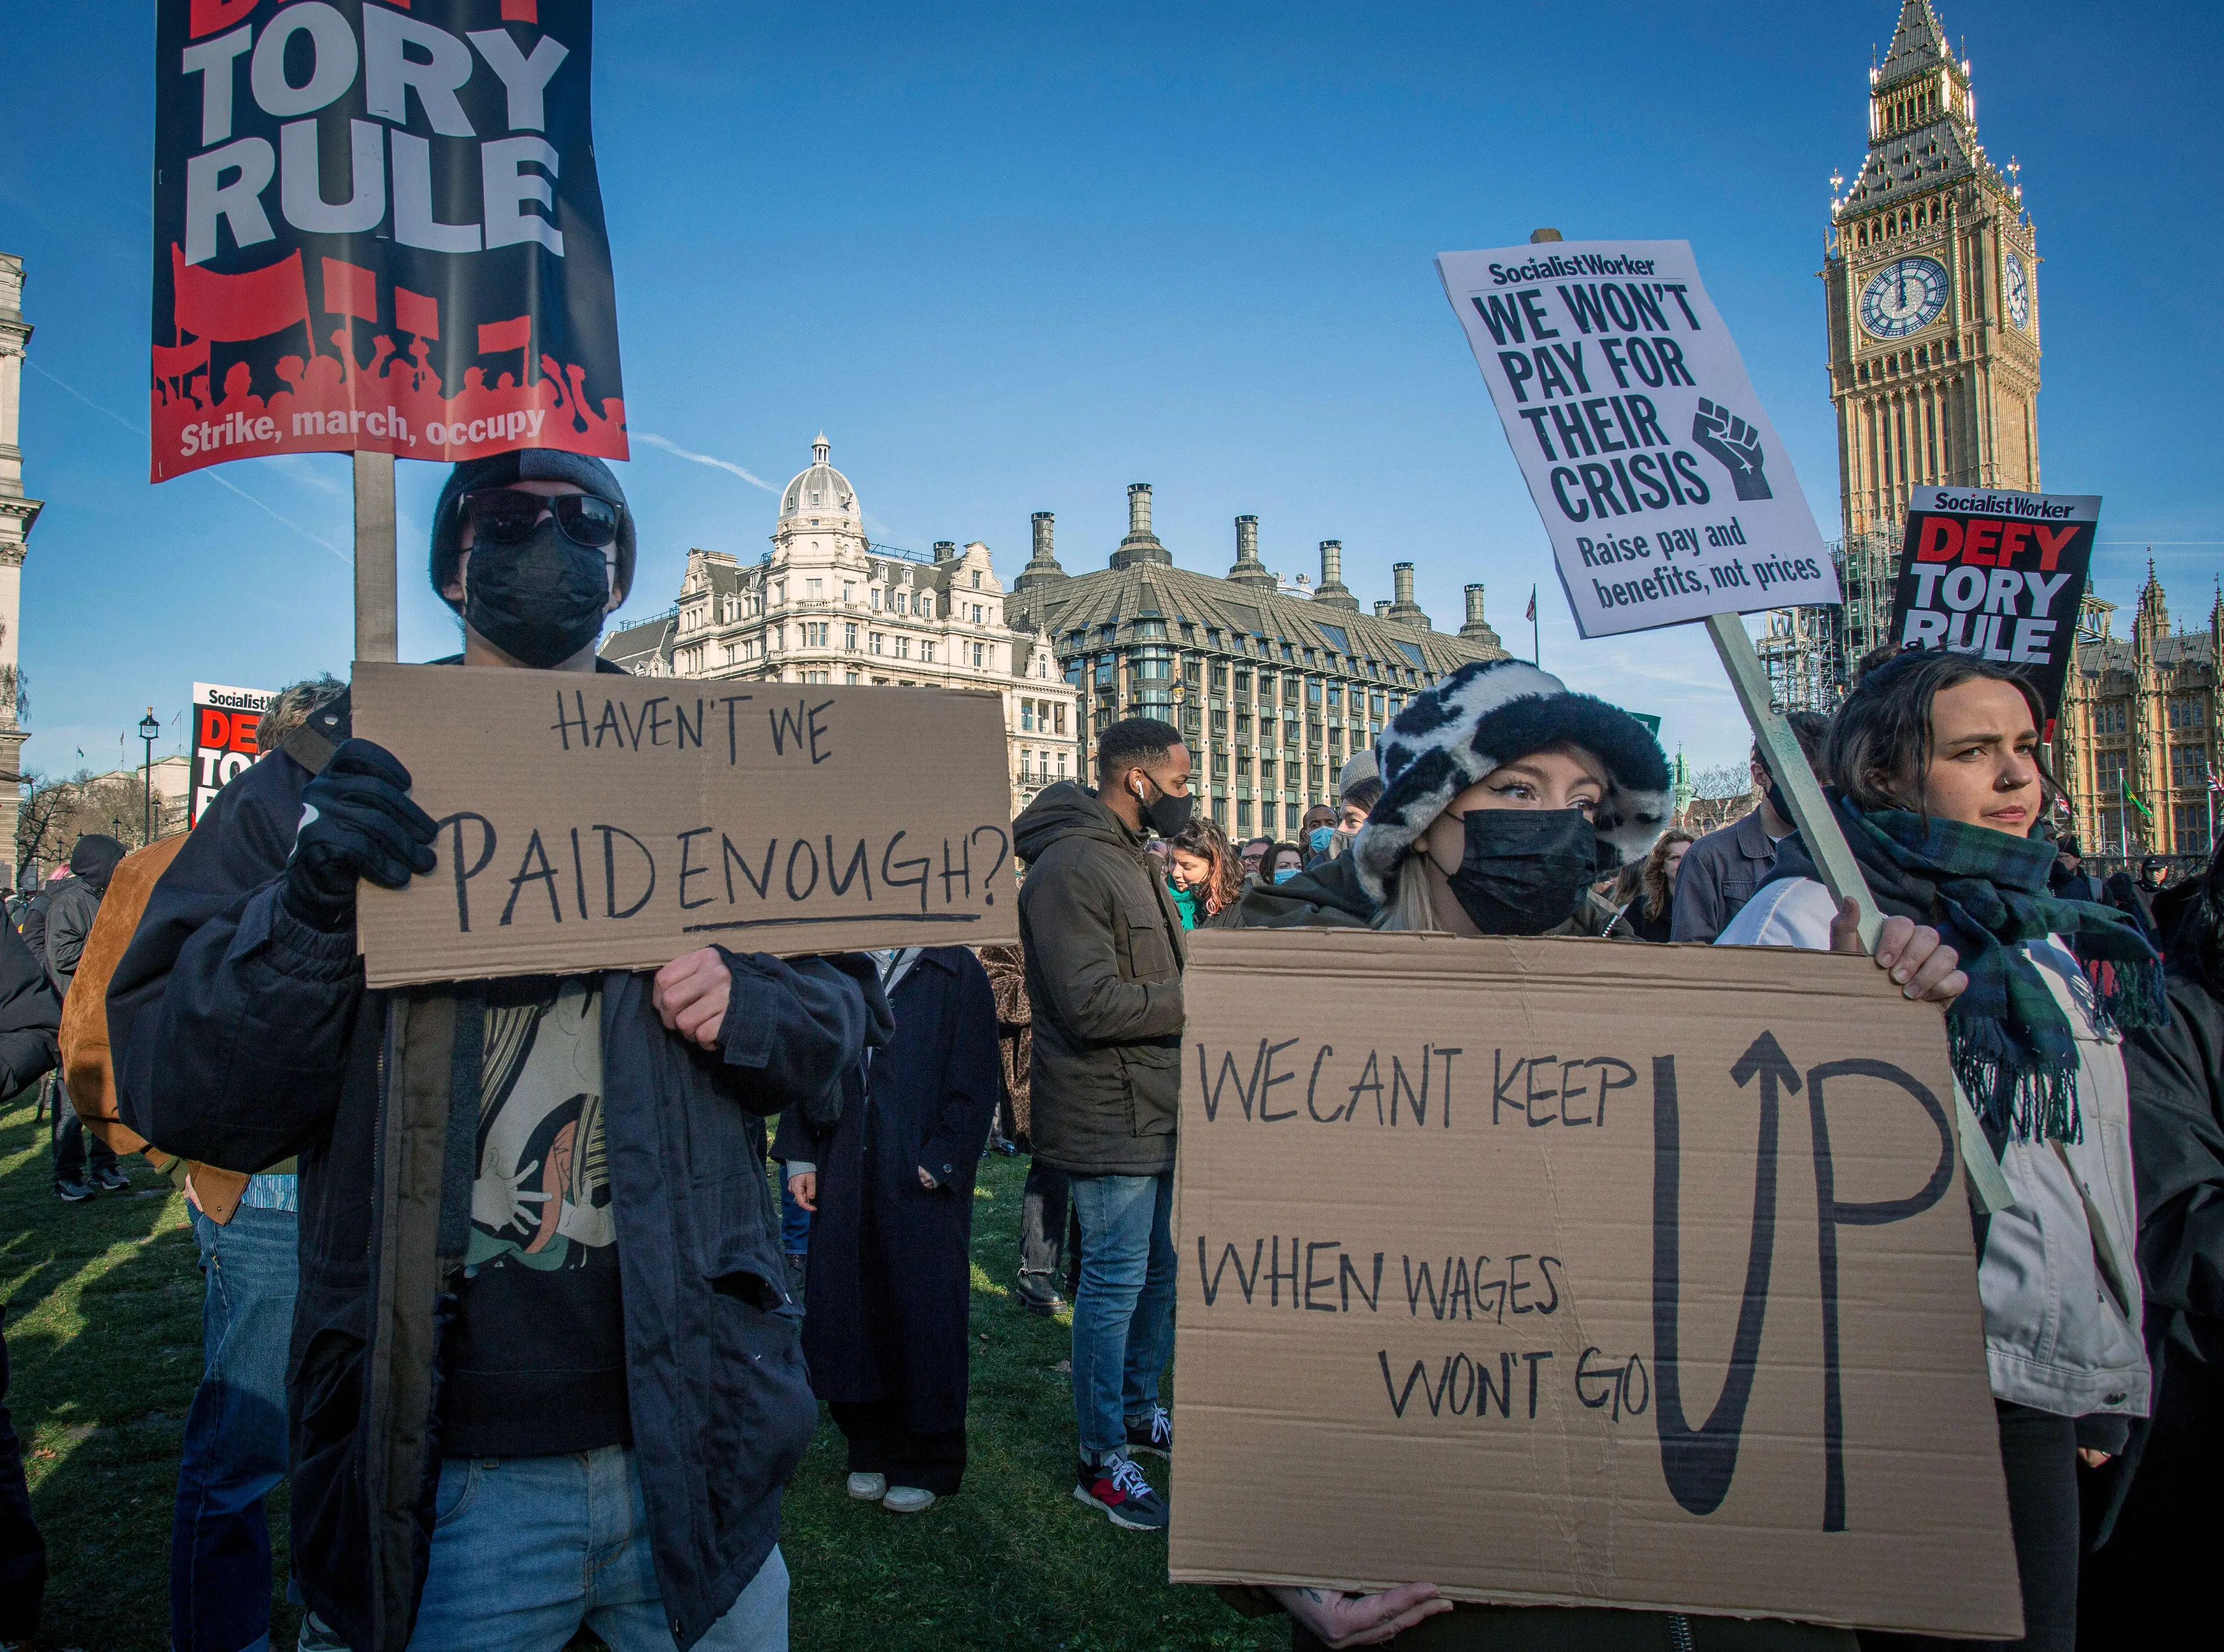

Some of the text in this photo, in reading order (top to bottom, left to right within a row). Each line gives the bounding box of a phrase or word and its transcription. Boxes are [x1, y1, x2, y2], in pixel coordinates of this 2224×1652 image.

[183, 1, 569, 147] TORY
[185, 119, 565, 266] RULE
[1471, 283, 1701, 346] WE WON'T
[1497, 336, 1696, 404] PAY FOR
[180, 406, 546, 457] Strike, march, occupy
[1519, 394, 1671, 463] THEIR
[1550, 450, 1710, 523] CRISIS
[1576, 516, 1747, 568] Raise pay and
[1916, 517, 2080, 570] DEFY
[1592, 554, 1821, 609] benefits, not prices
[1910, 563, 2072, 617] TORY
[1901, 609, 2057, 664] RULE
[200, 709, 261, 754] DE
[551, 689, 835, 765] HAVEN'T WE
[197, 747, 261, 787] TO
[436, 812, 1009, 933] PAID ENOUGH?
[1197, 1037, 1638, 1129] WE CAN'T KEEP
[1198, 1235, 1563, 1325] WHEN WAGES
[1652, 1030, 1955, 1532] UP
[1377, 1346, 1649, 1424] WON'T GO
